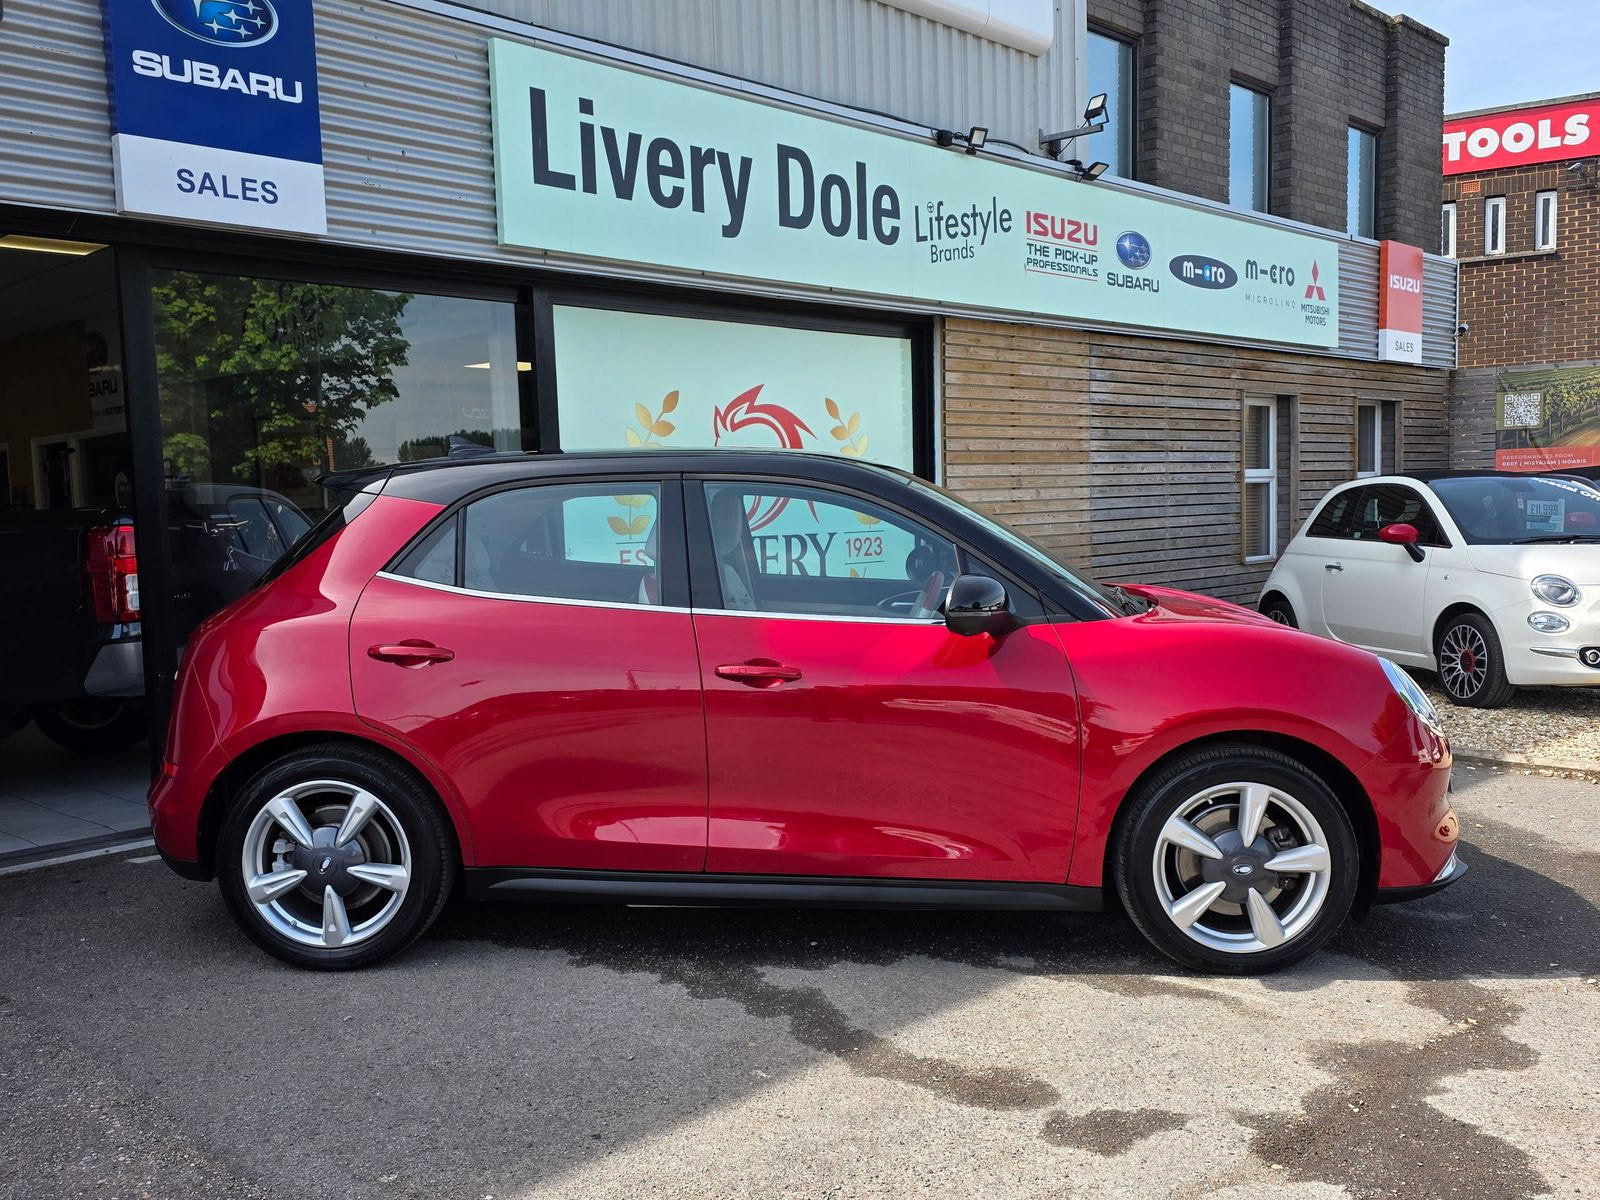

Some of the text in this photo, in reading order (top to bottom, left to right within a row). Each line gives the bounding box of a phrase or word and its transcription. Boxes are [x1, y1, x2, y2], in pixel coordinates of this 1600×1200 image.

[132, 49, 303, 104] SUBARU
[1443, 113, 1590, 162] TOOLS
[529, 86, 901, 246] Livery Dole
[176, 168, 279, 205] SALES
[914, 196, 1012, 246] Lifestyle
[1026, 210, 1098, 247] ISUZU
[930, 240, 975, 263] Brands
[1026, 242, 1098, 265] THE PICK-UP
[1026, 257, 1098, 278] PROFESSIONALS
[1106, 272, 1160, 293] SUBARU
[1389, 274, 1420, 294] ISUZU
[1245, 293, 1296, 309] MICROLINO
[1300, 303, 1330, 316] MITSUBISHI
[1305, 315, 1326, 327] MOTORS
[1395, 340, 1414, 353] SALES
[89, 378, 117, 397] BARU
[619, 549, 648, 567] ES
[752, 532, 838, 577] ERY
[845, 536, 883, 558] 1923
